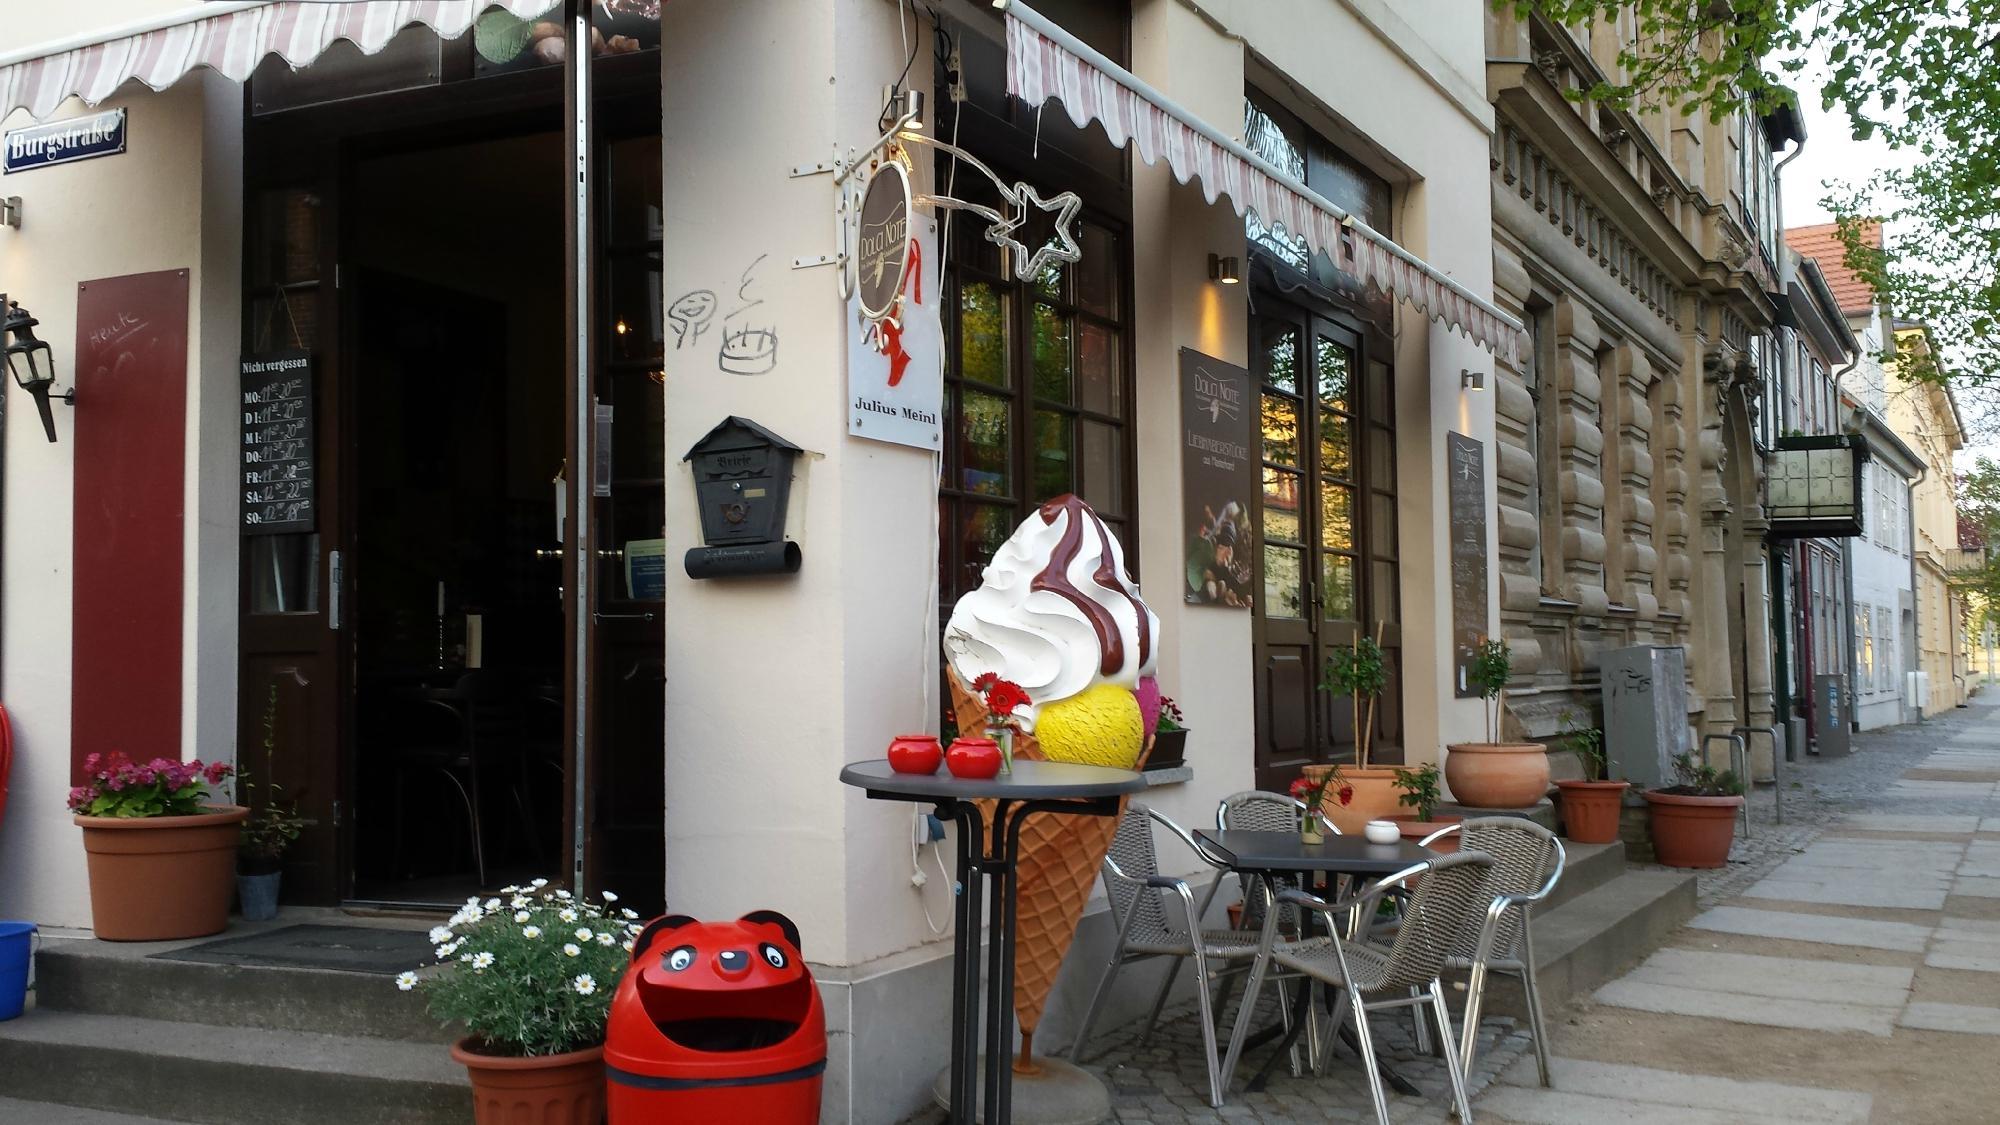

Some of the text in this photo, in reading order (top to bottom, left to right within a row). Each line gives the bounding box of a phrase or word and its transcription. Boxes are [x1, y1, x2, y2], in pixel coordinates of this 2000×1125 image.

[11, 119, 114, 160] Burgstraße
[242, 358, 307, 373] Nicht vergessen
[855, 397, 937, 425] Julius Meinl
